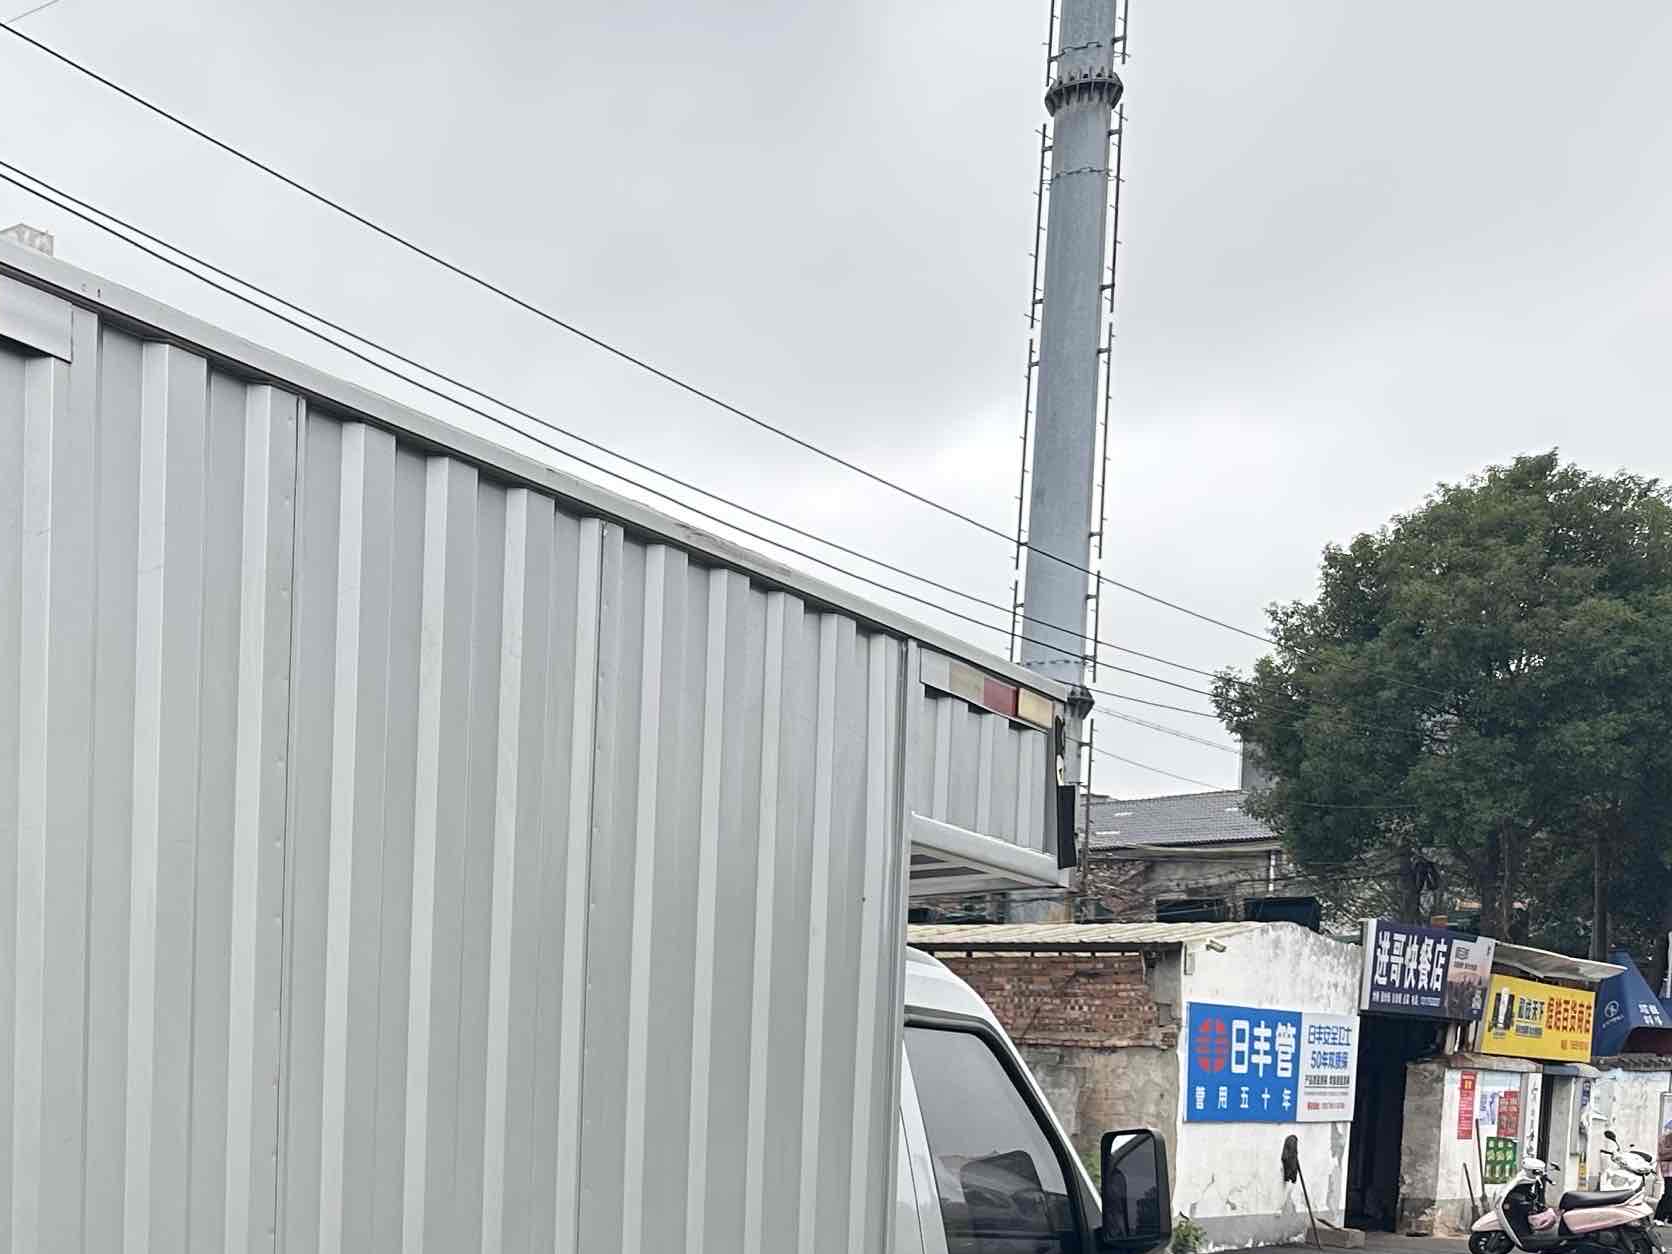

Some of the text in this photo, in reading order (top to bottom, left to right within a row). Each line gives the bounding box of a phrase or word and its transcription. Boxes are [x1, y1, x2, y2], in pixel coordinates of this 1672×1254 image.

[1374, 931, 1448, 993] 进哥快餐店
[1231, 1019, 1296, 1078] 日丰管
